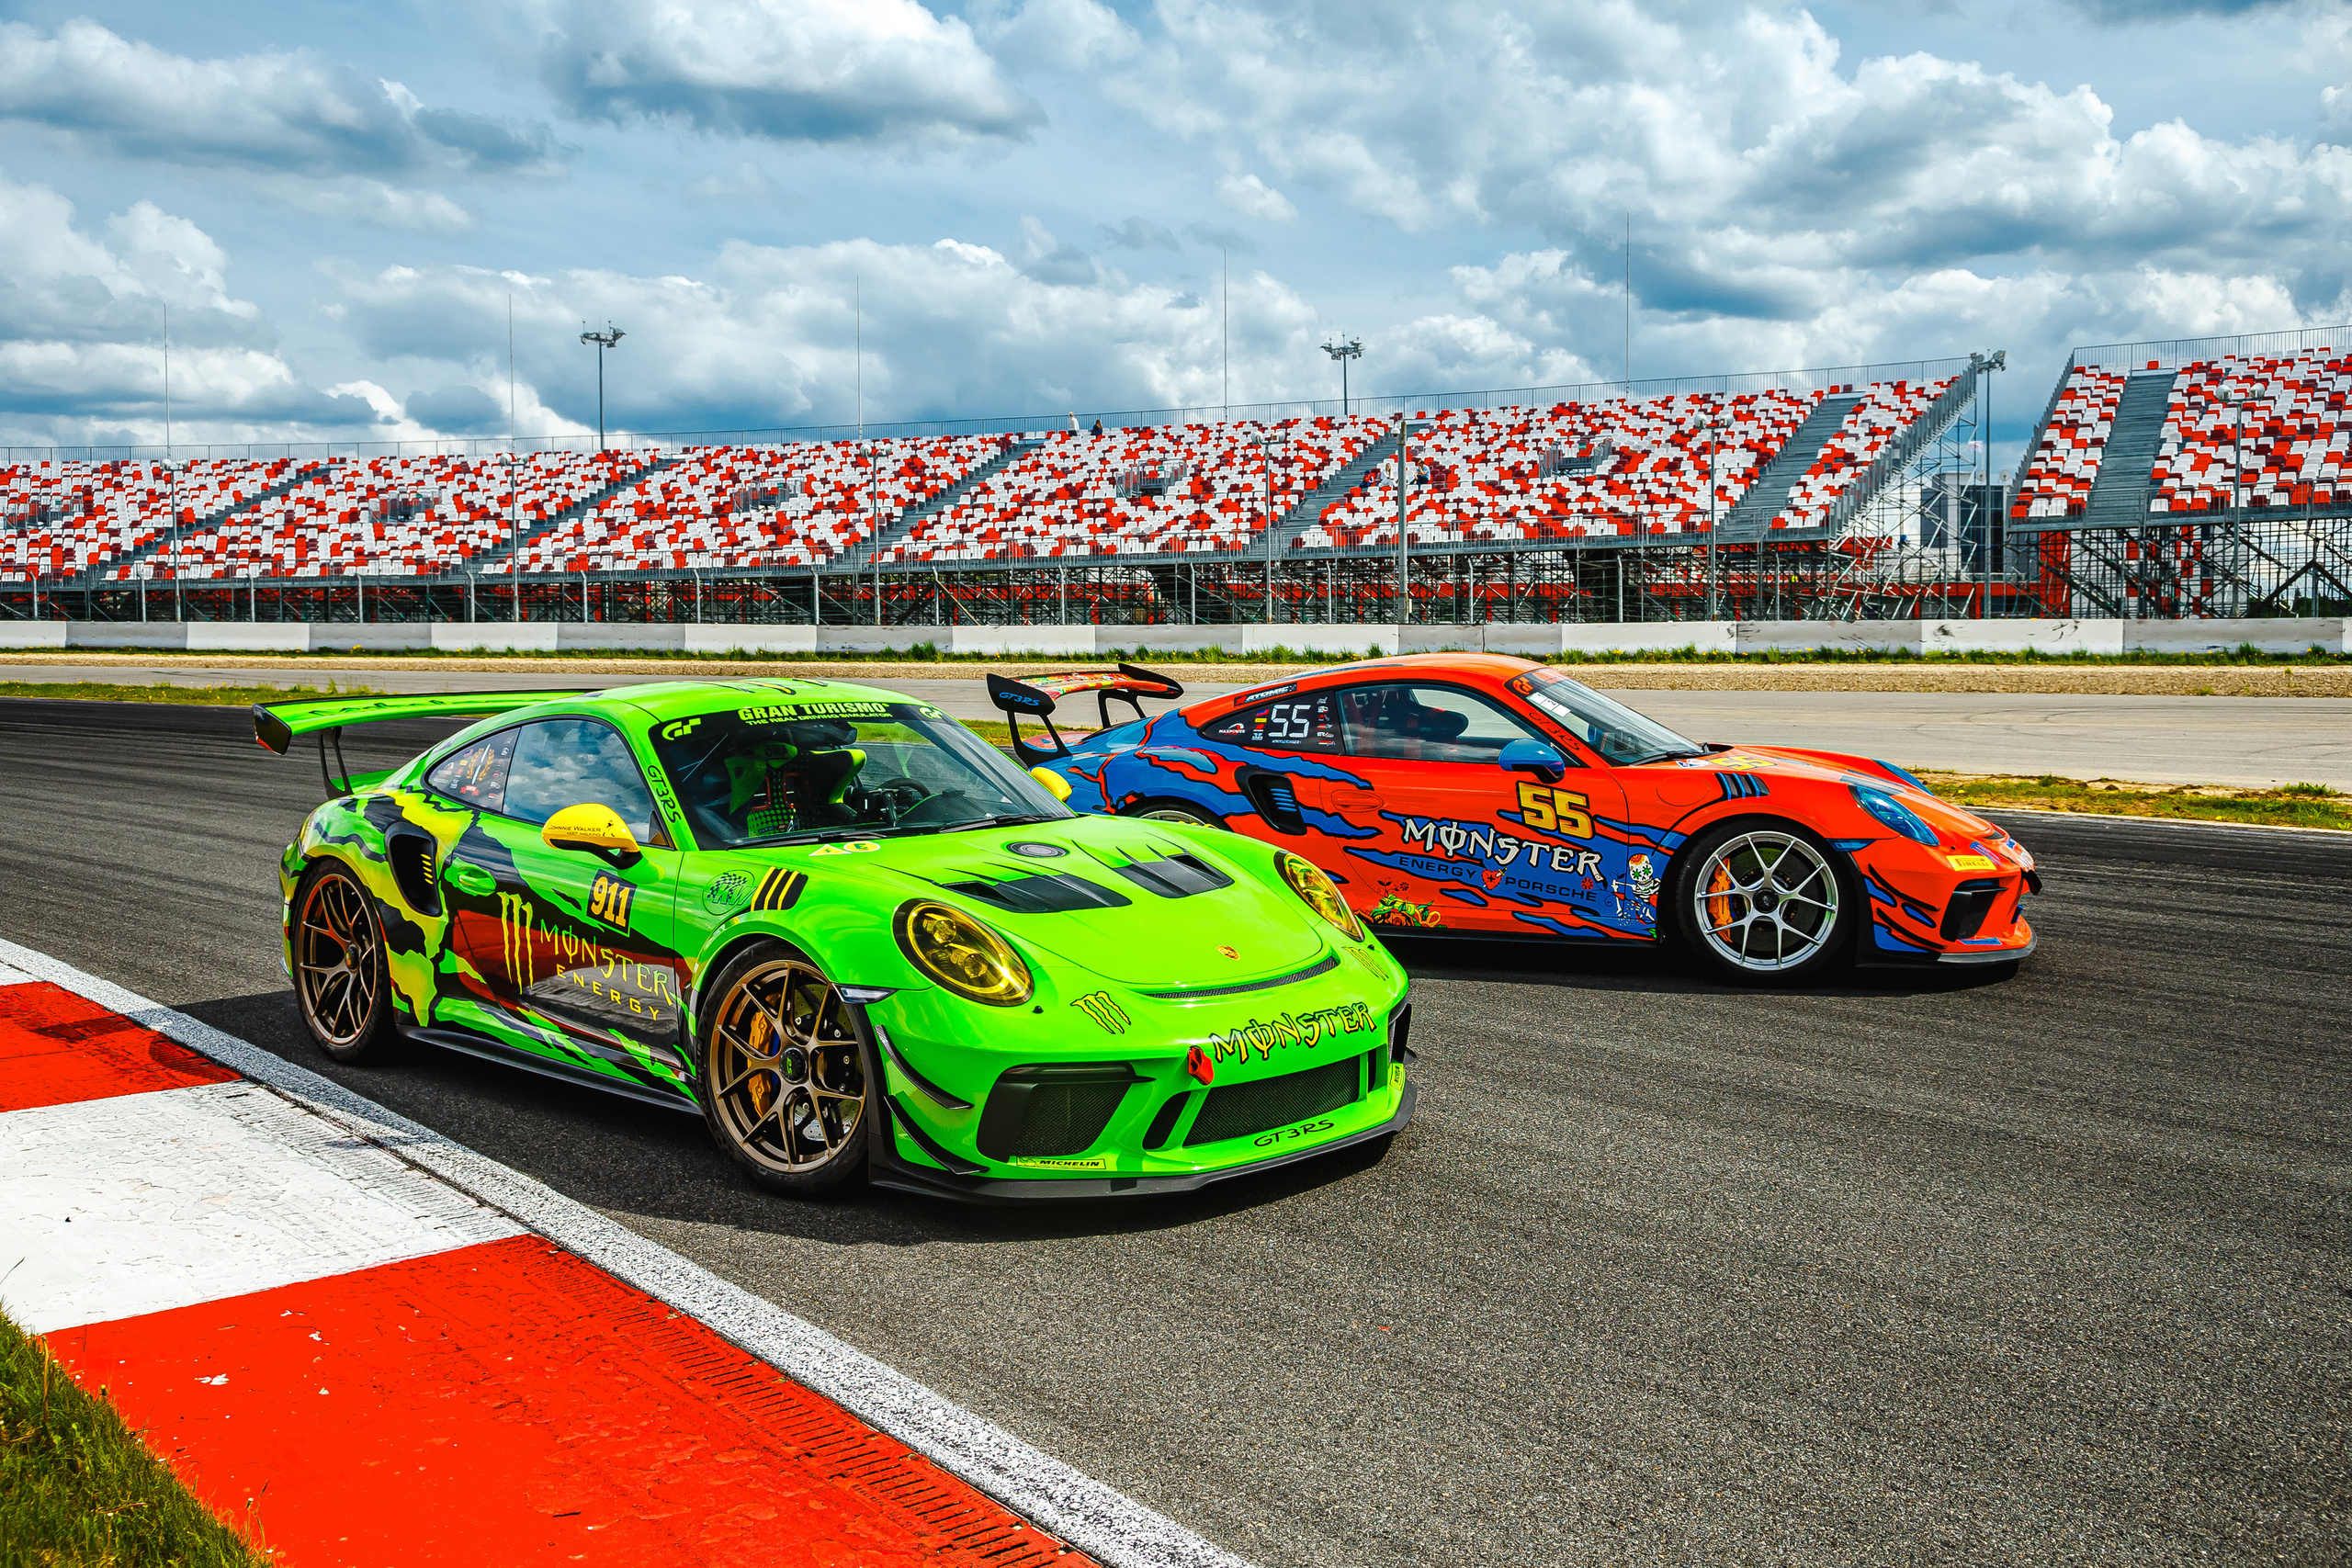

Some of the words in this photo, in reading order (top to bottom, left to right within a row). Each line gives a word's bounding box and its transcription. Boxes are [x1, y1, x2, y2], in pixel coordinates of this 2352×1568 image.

[738, 705, 797, 721] GRAN
[799, 703, 888, 716] TURISMO
[999, 692, 1040, 706] GT3RS
[1245, 686, 1289, 702] ATOMIC
[1269, 705, 1311, 738] 55
[1529, 711, 1581, 751] GT3RS
[1708, 755, 1777, 771] 55
[646, 764, 682, 824] GT3RS
[1517, 781, 1595, 840] 55
[1399, 857, 1477, 879] ENERGY
[1505, 877, 1597, 902] PORSCHE
[1955, 858, 1990, 867] PIRELLI
[591, 876, 630, 928] 911
[539, 919, 673, 1006] MONSTER
[556, 964, 660, 1021] ENERGY
[1209, 1001, 1377, 1065] MONSTER
[1253, 1119, 1335, 1146] GT3RS
